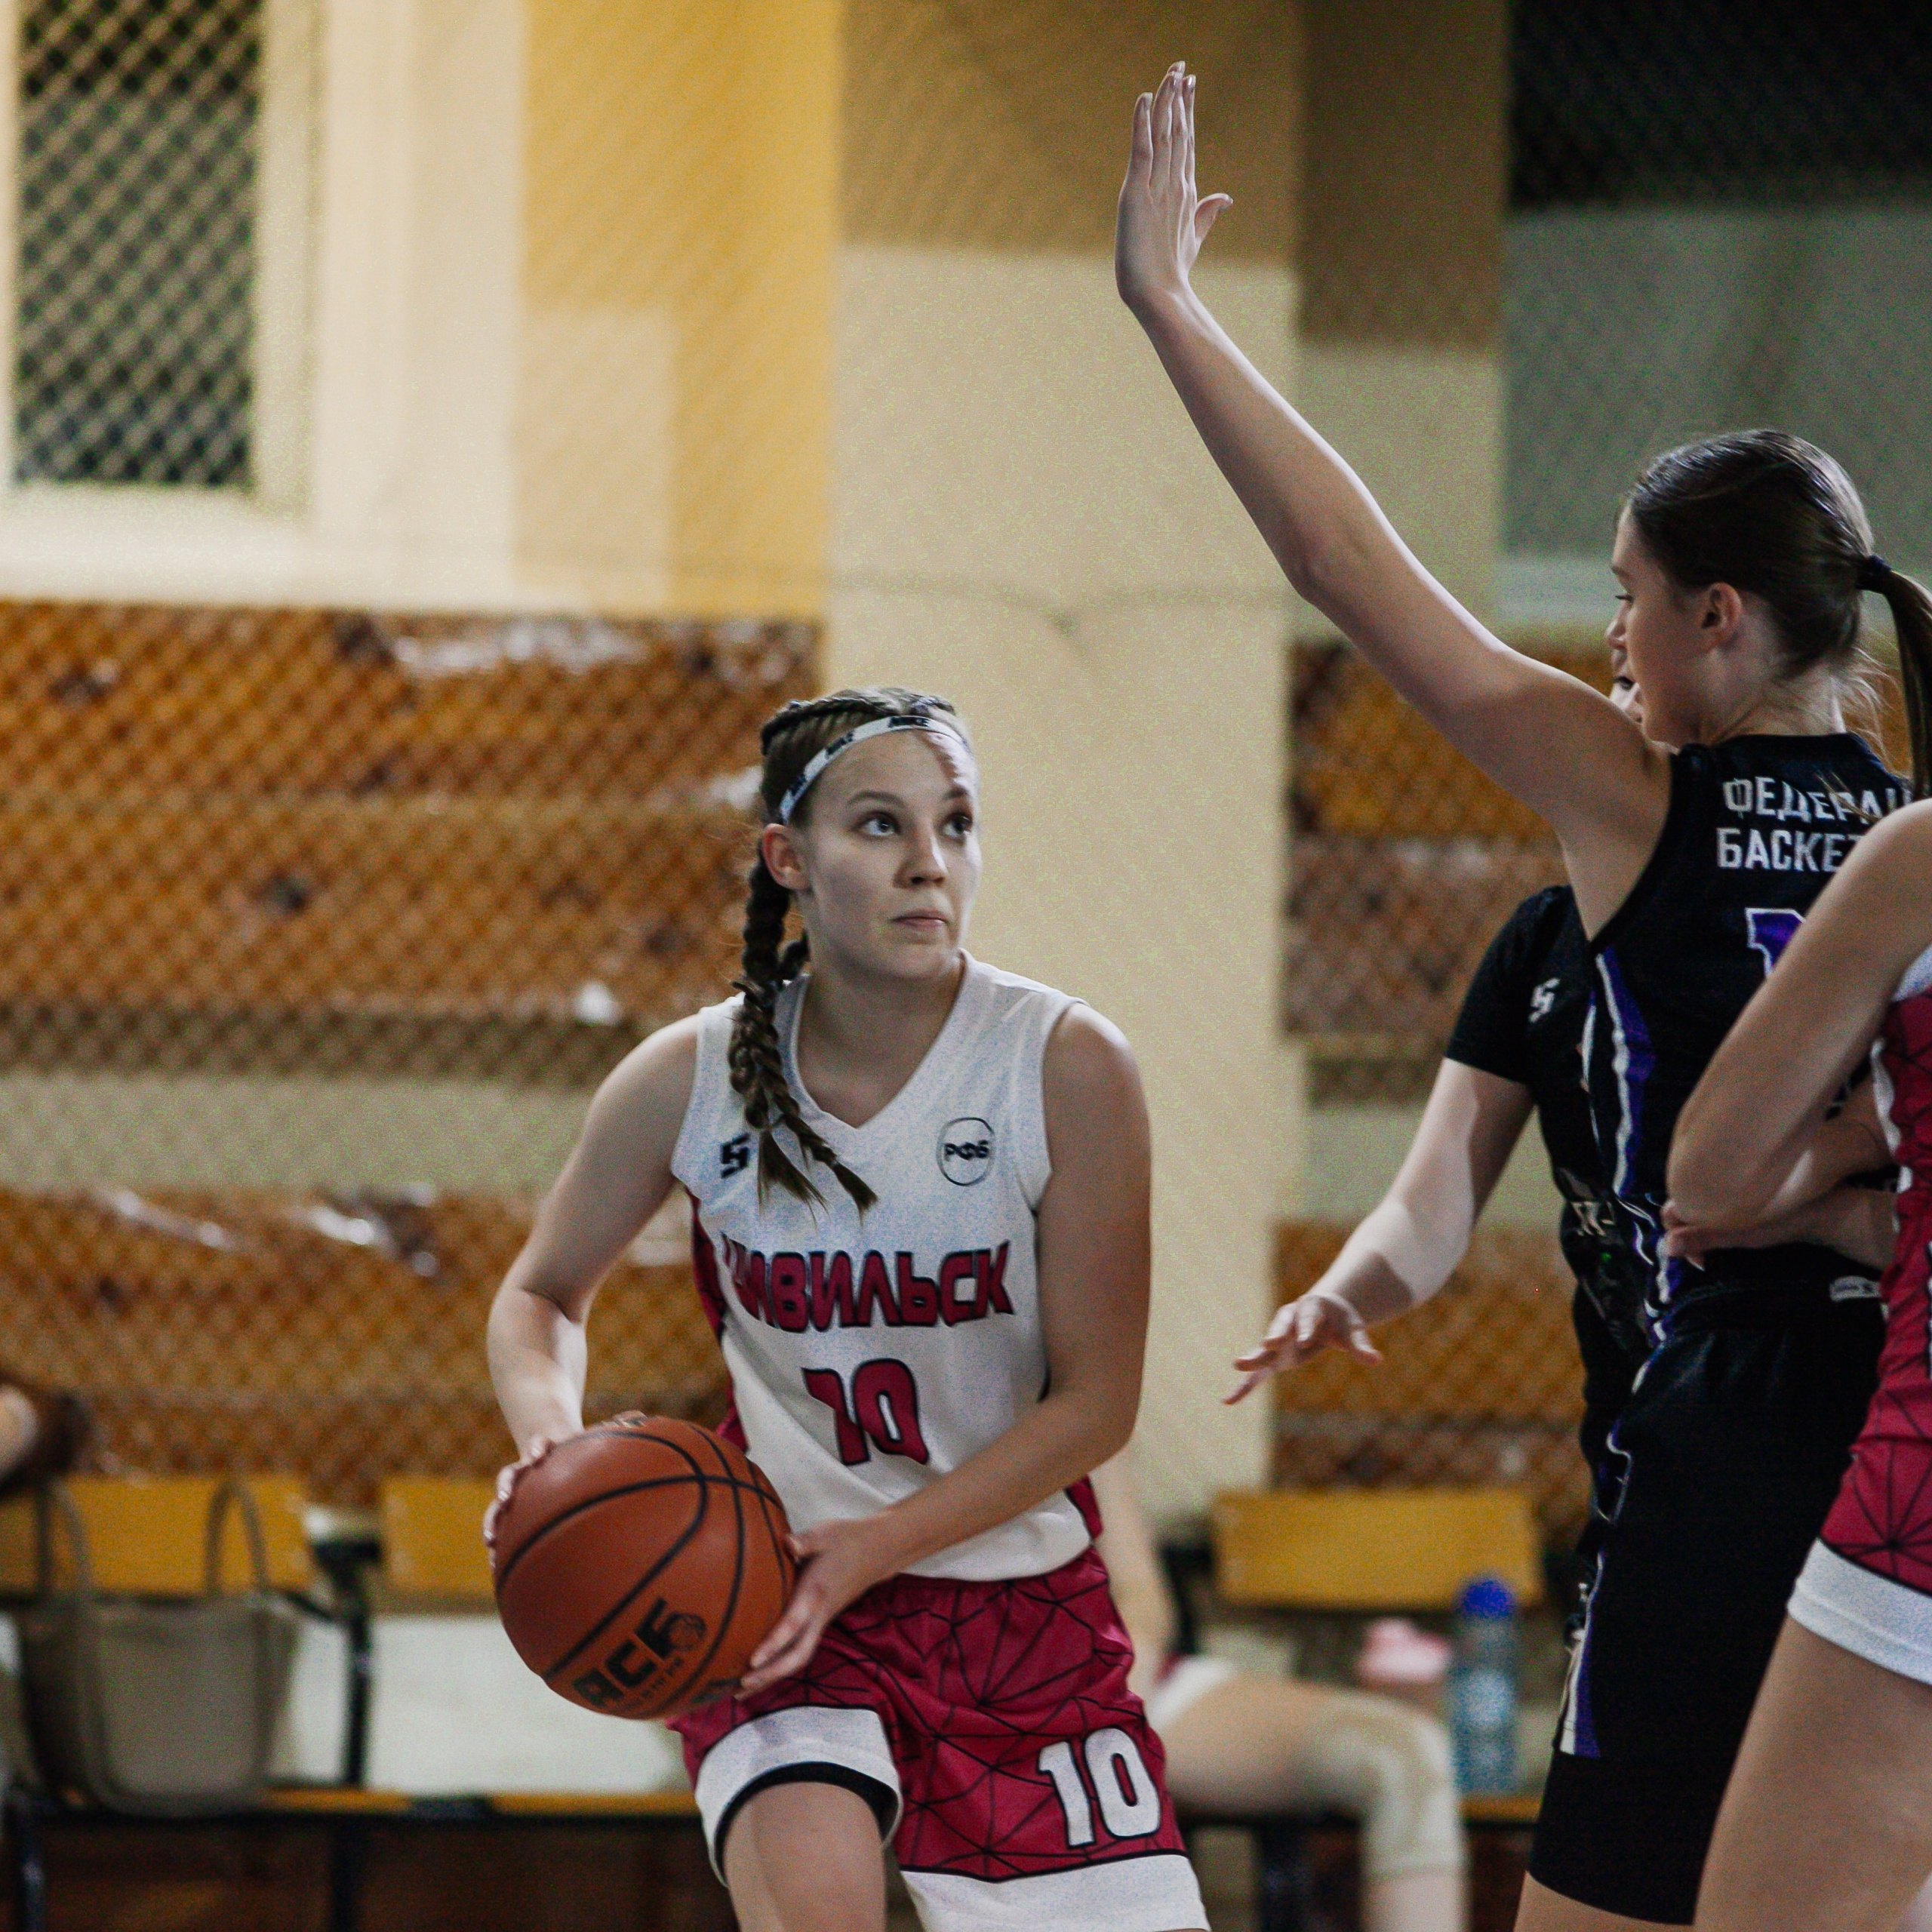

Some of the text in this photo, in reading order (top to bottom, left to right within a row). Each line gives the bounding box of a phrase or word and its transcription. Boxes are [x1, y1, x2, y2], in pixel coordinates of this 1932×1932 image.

[721, 1232, 1014, 1334] ИВИЛЬСК
[801, 1357, 929, 1467] 10
[1038, 1725, 1162, 1847] 10
